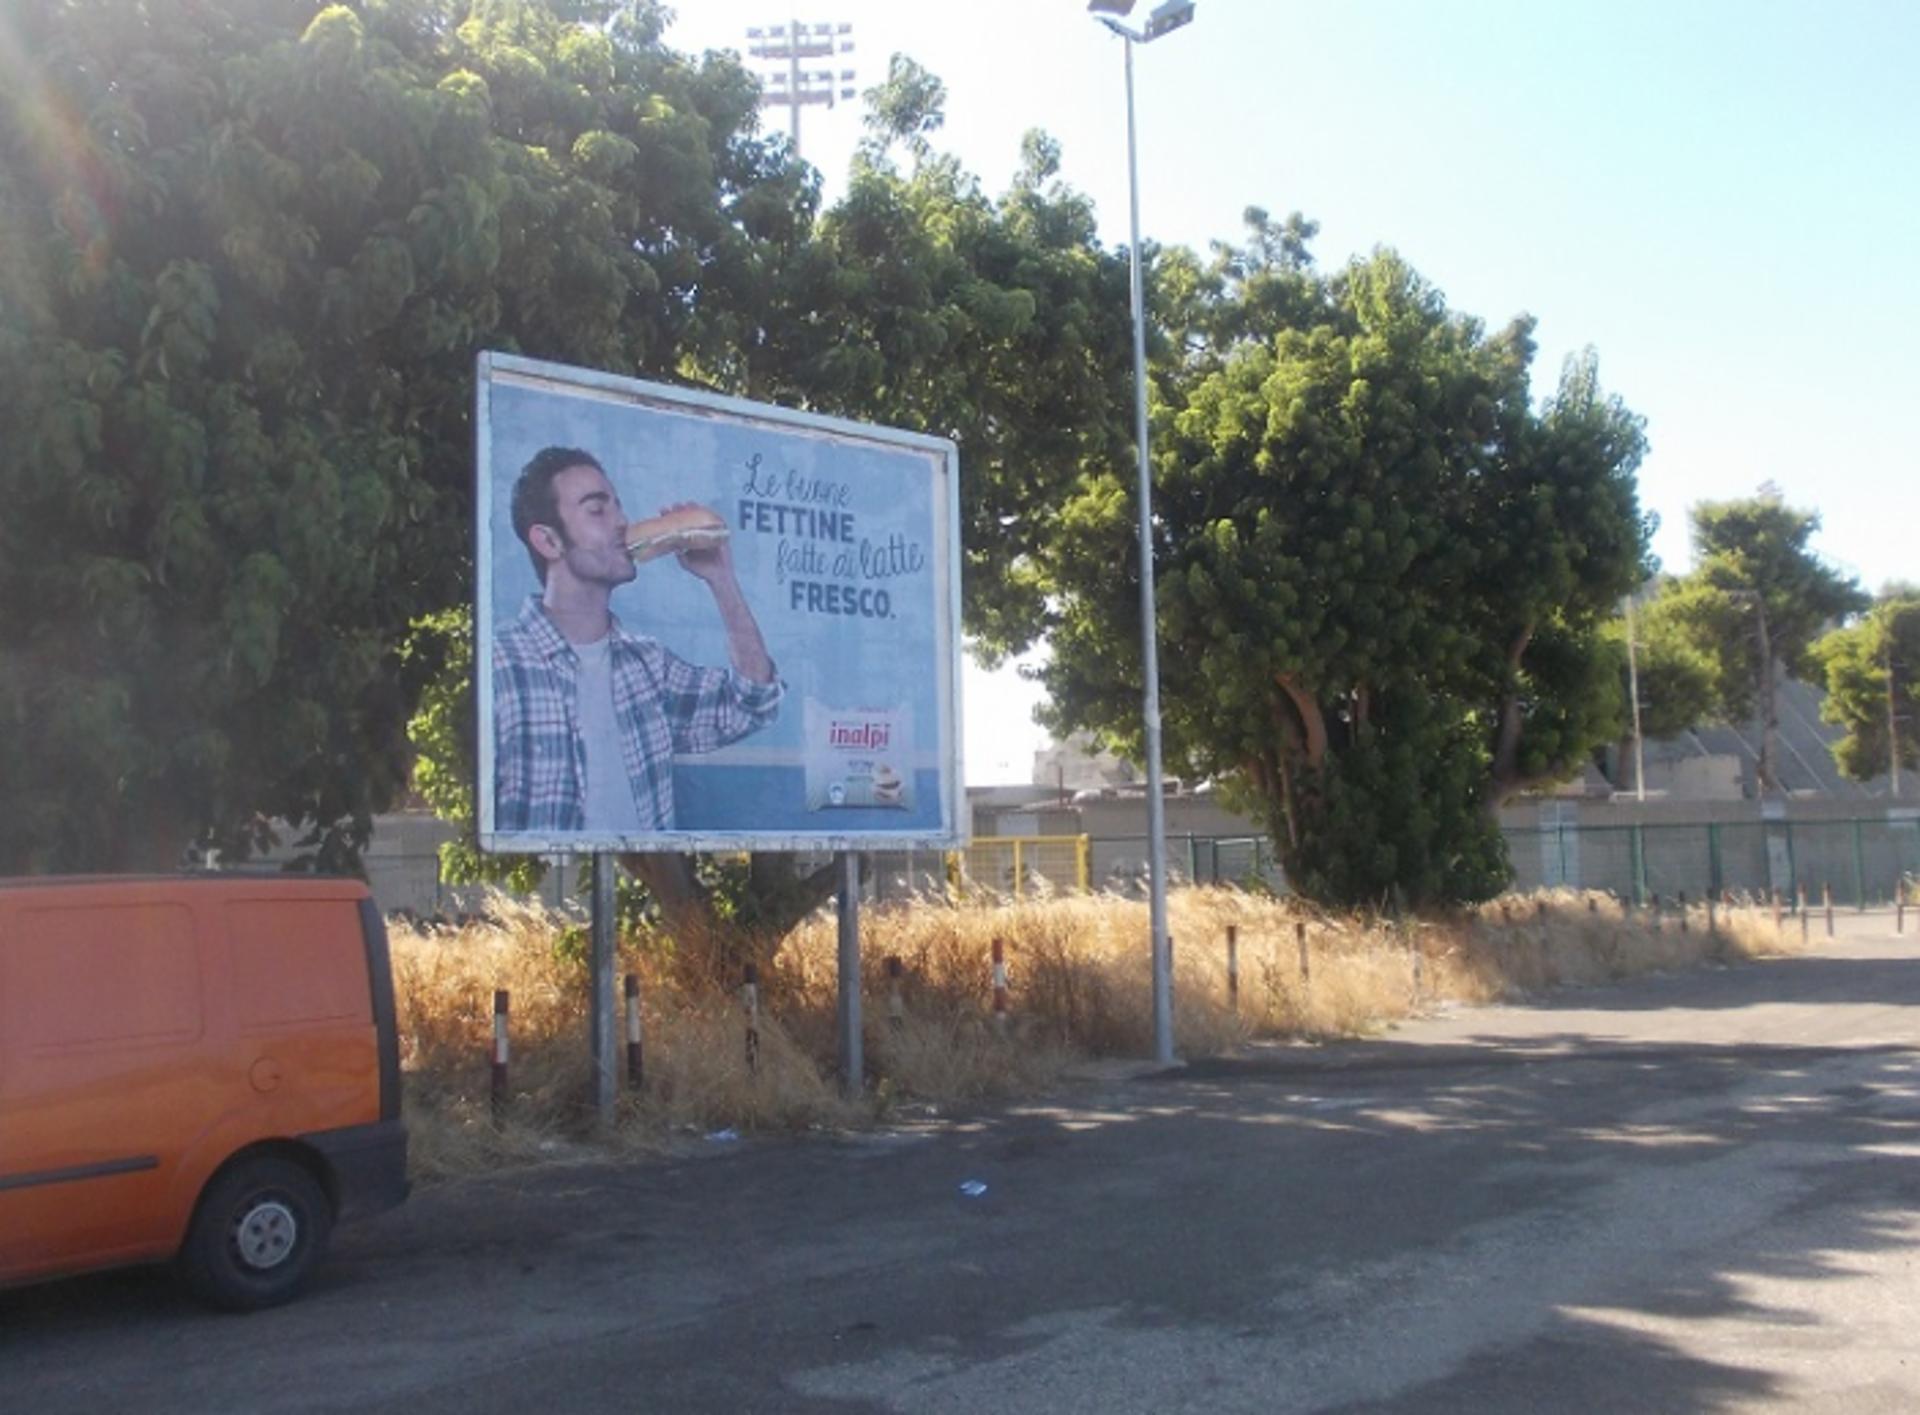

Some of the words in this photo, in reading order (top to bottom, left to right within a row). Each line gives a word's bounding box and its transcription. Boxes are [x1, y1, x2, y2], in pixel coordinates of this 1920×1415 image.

[743, 453, 781, 498] Le
[739, 500, 855, 544] FETTINE
[776, 538, 826, 585] fatte
[859, 532, 925, 580] latte
[791, 580, 896, 619] FRESCO.
[829, 720, 891, 750] inalpi
